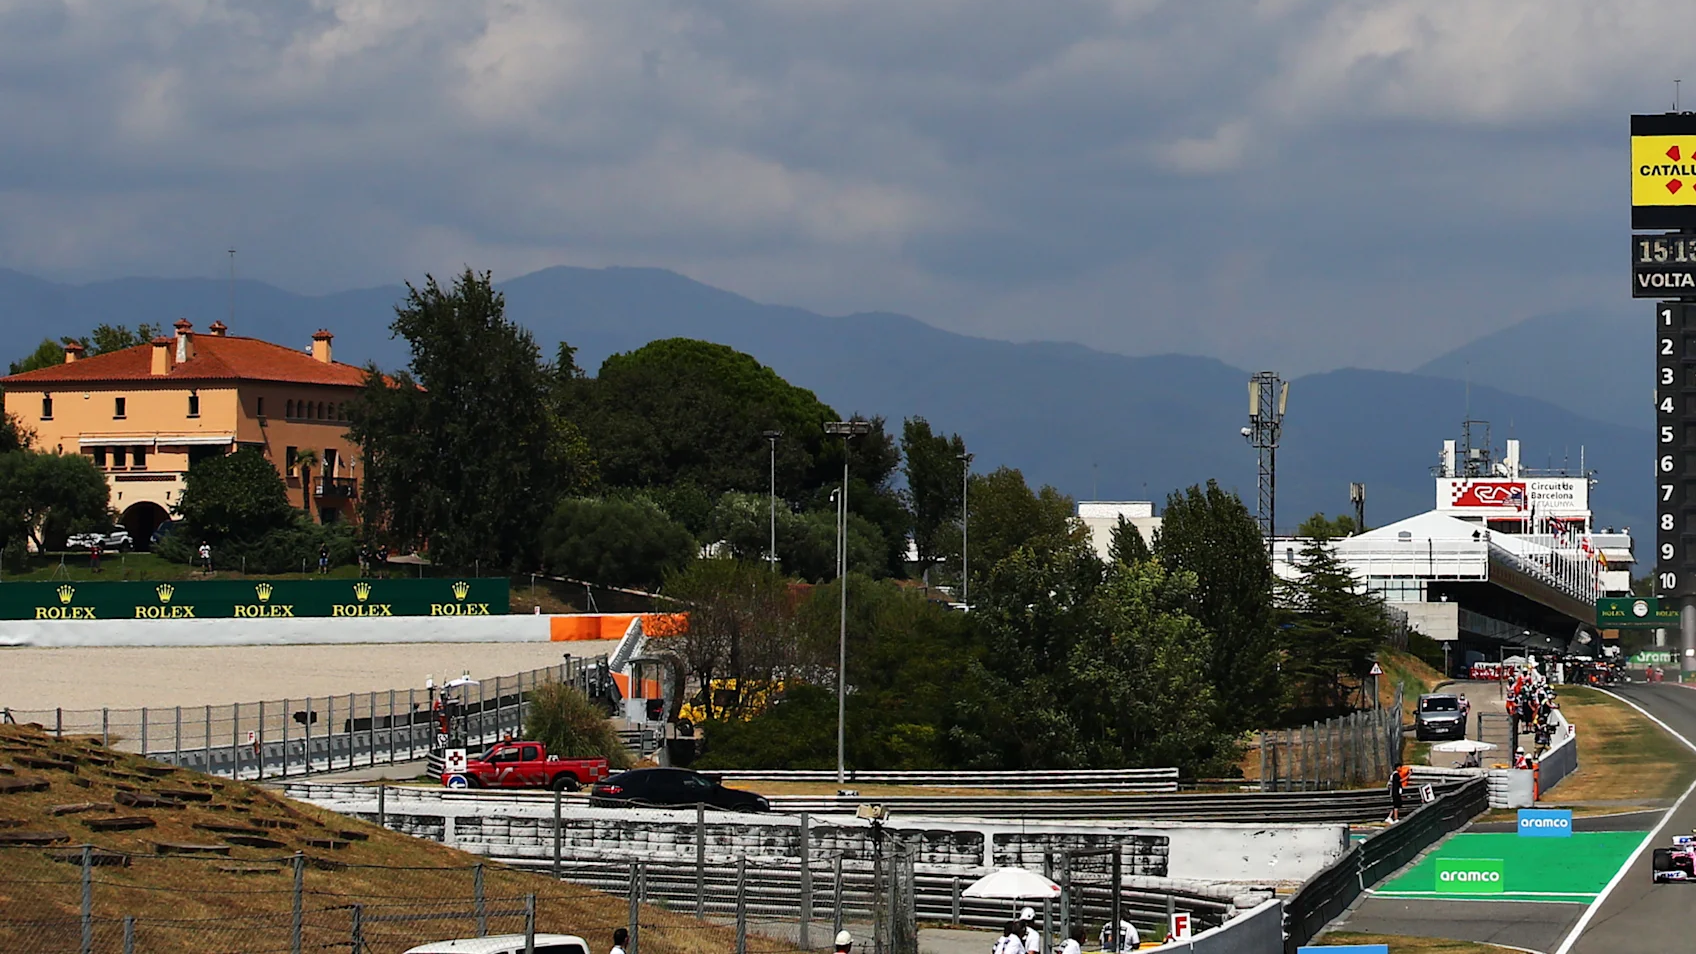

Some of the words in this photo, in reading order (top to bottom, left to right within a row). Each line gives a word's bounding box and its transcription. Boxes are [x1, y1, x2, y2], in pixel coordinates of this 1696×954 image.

[1638, 273, 1696, 287] VOLTA
[1661, 309, 1671, 325] 1
[1661, 339, 1674, 355] 2
[1661, 368, 1674, 384] 3
[1660, 397, 1674, 413] 4
[1661, 426, 1674, 442] 5
[1660, 455, 1674, 472] 6
[1531, 482, 1561, 491] Circuit
[1661, 485, 1674, 501] 7
[1661, 514, 1674, 530] 8
[1661, 543, 1674, 560] 9
[1660, 572, 1677, 589] 10
[35, 607, 96, 619] ROLEX
[135, 606, 195, 618] ROLEX
[234, 604, 294, 617] ROLEX
[332, 604, 393, 616] ROLEX
[430, 603, 490, 616] ROLEX
[1424, 786, 1431, 800] F
[1521, 818, 1569, 827] aramco
[1440, 871, 1500, 882] aramco
[1175, 916, 1187, 937] F
